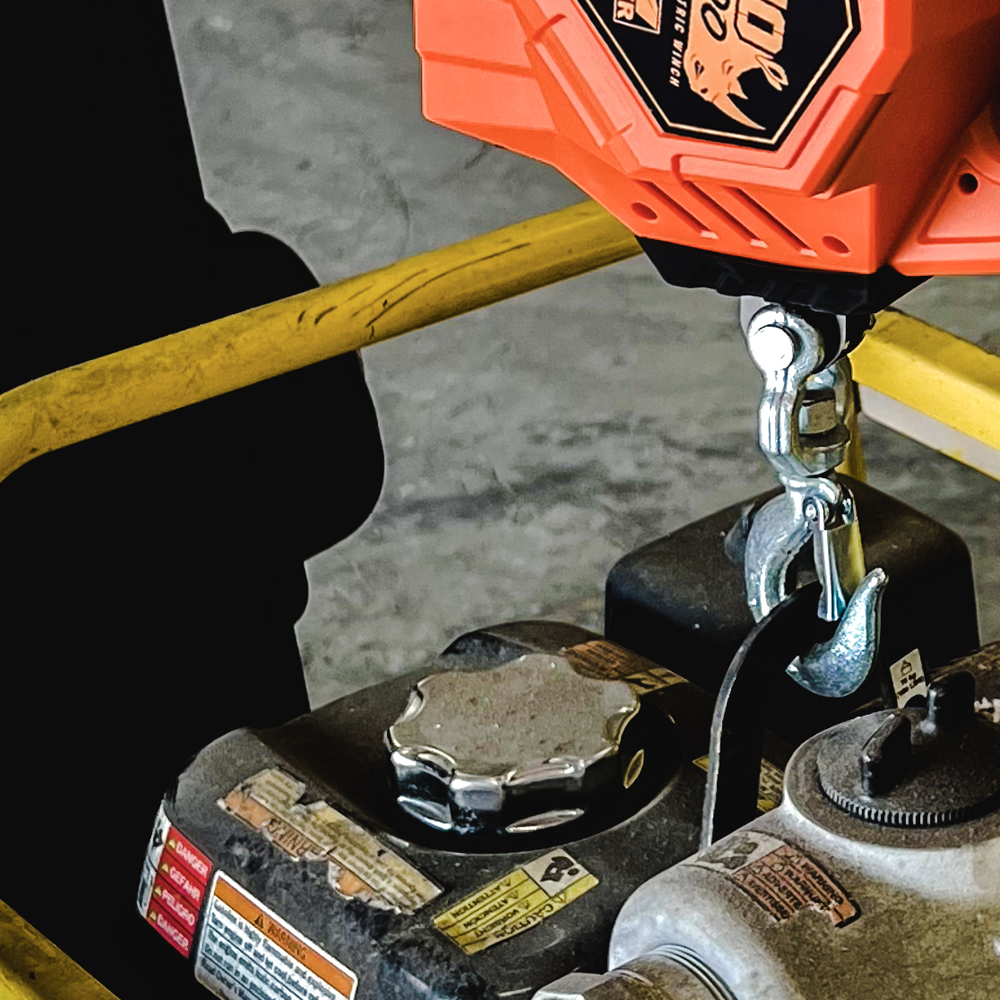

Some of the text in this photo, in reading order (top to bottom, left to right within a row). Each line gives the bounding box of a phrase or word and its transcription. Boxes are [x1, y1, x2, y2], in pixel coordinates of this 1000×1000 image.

[669, 38, 684, 88] WINCH
[176, 841, 209, 879] DANGER
[169, 866, 201, 902] GEFAHR
[161, 889, 195, 926] PELIGRO
[452, 887, 502, 919] ATTENTION
[493, 904, 554, 939] CAUTION
